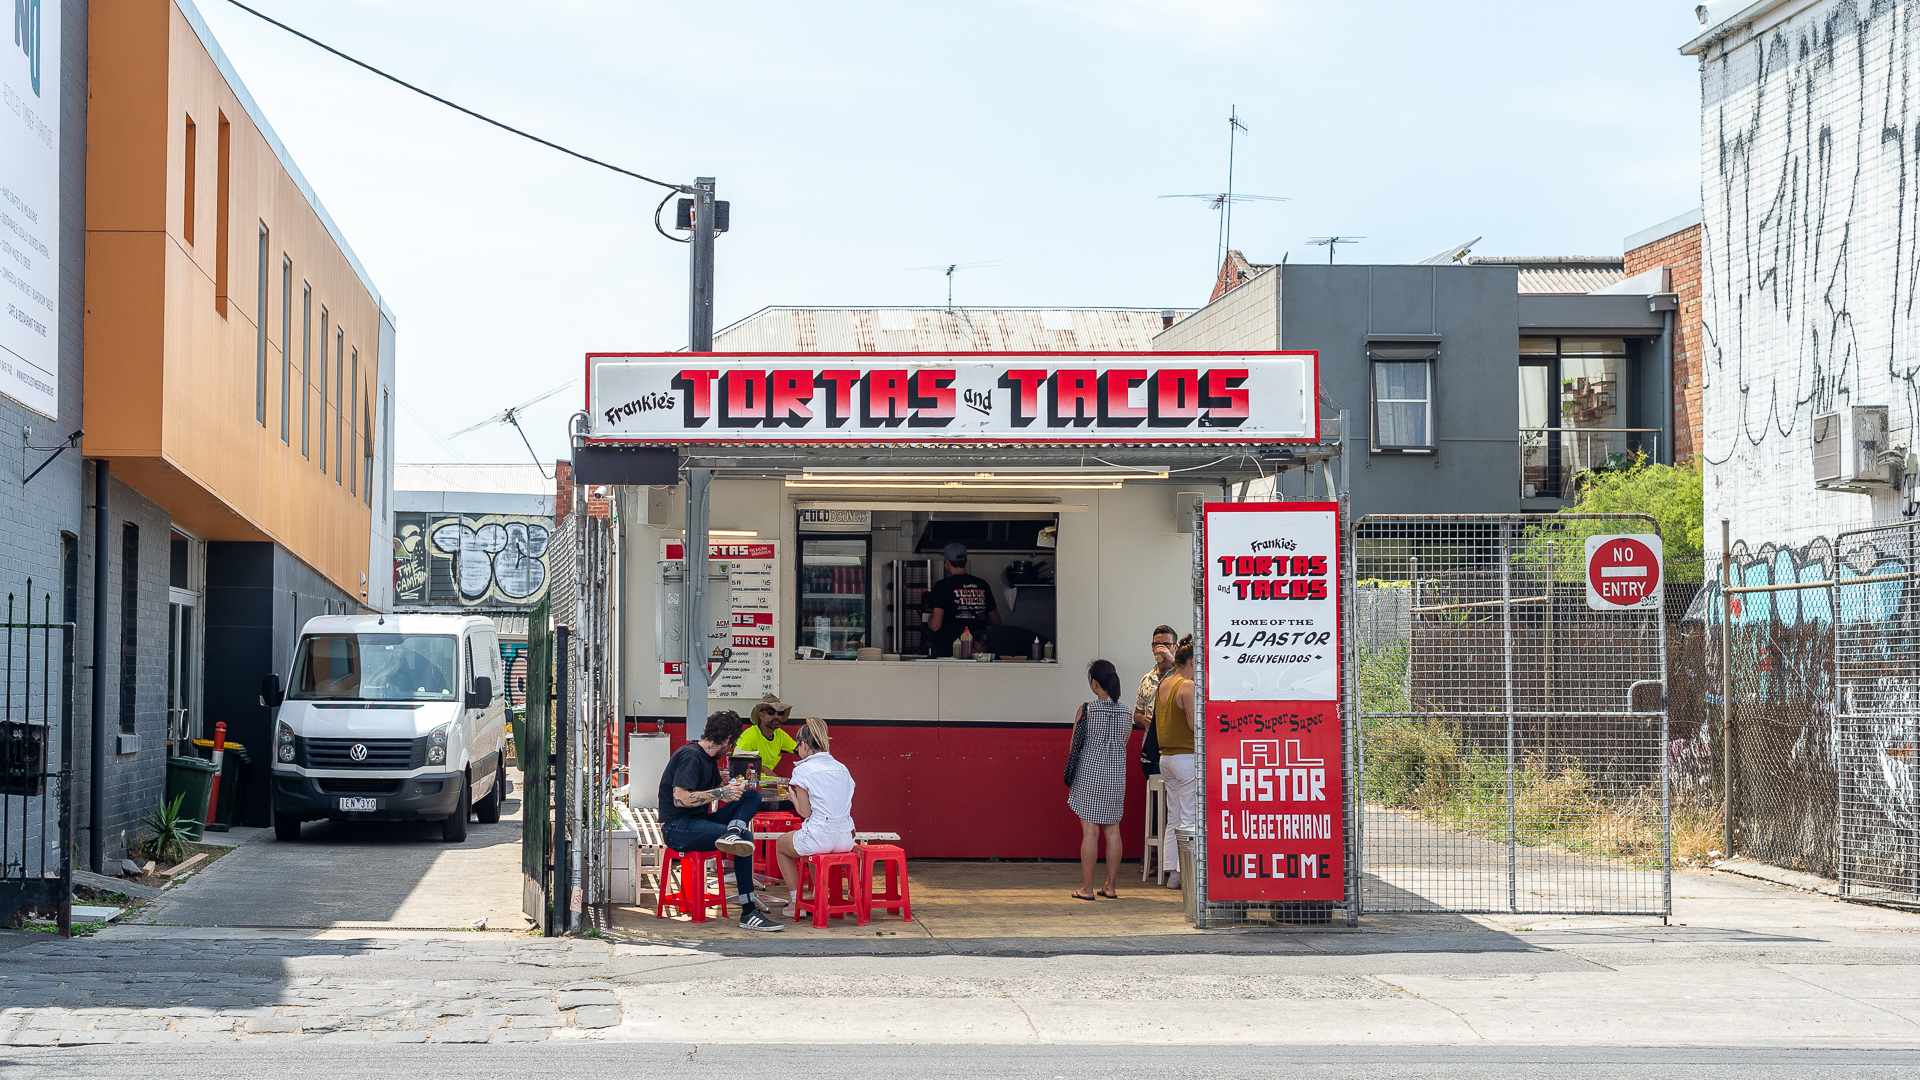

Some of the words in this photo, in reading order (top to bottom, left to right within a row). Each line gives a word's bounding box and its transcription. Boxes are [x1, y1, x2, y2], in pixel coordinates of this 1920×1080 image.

[605, 391, 676, 427] Frankie's
[670, 370, 956, 428] TORTAS
[963, 387, 992, 412] and
[998, 369, 1249, 428] TACOS
[708, 545, 749, 556] RTAS
[1250, 537, 1297, 553] Frankie's
[1613, 547, 1634, 562] NO
[1217, 555, 1328, 577] TORTAS
[1217, 584, 1231, 594] and
[1232, 579, 1328, 600] TACOS
[1602, 581, 1647, 597] ENTRY
[1215, 630, 1246, 648] AL
[1246, 630, 1331, 649] PASTOR
[1219, 713, 1253, 733] Super
[1254, 713, 1289, 733] Super
[1289, 713, 1324, 734] Super
[1240, 739, 1324, 767] AL
[1221, 758, 1326, 802] PASTOR
[1242, 810, 1332, 840] VEGETARIANO
[1223, 853, 1330, 879] WELCOME
